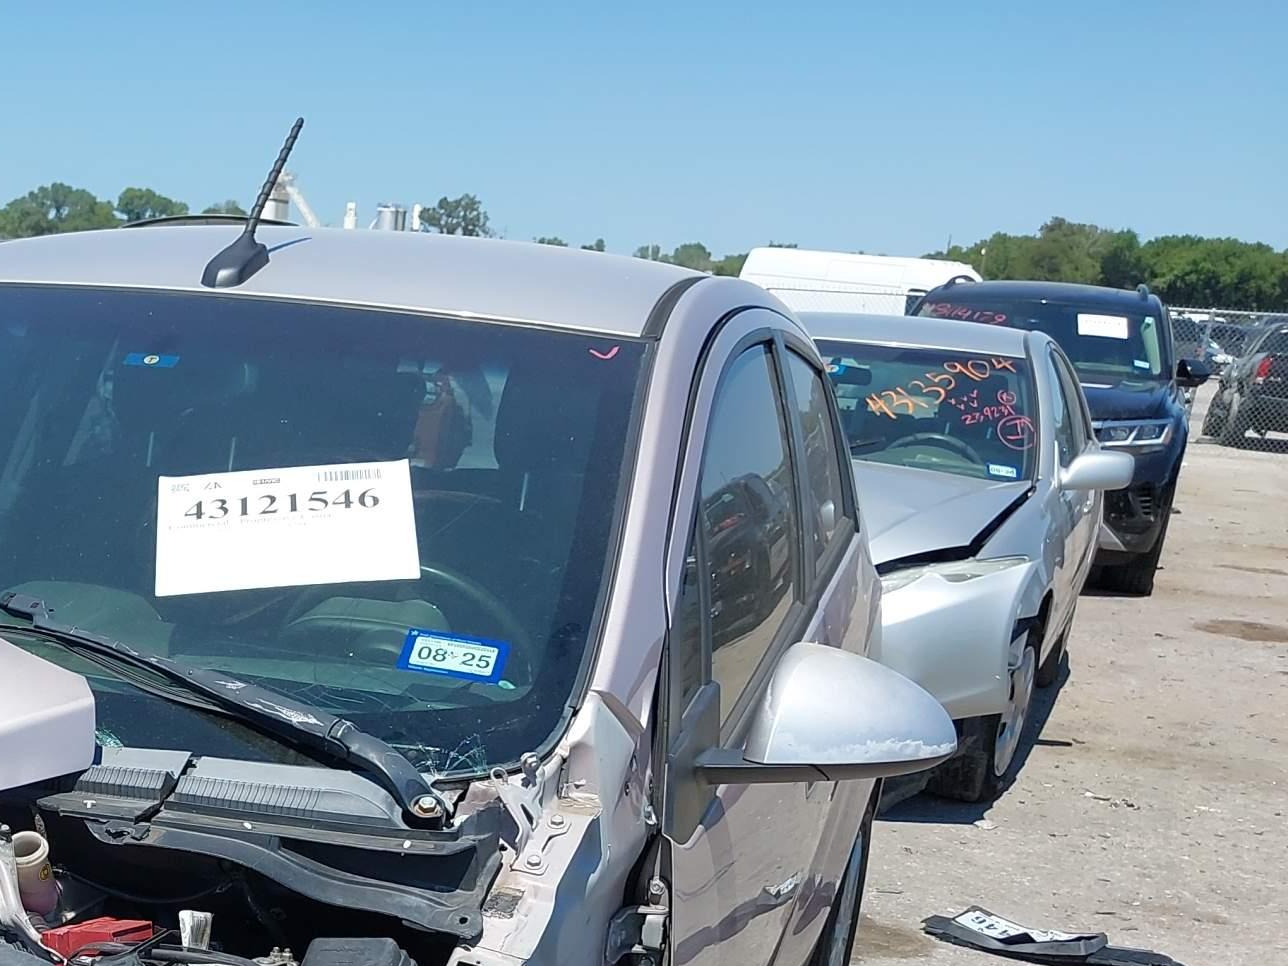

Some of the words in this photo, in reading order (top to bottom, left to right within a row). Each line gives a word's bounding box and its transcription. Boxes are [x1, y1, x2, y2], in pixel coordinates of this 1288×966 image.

[865, 357, 1017, 420] 43135904
[184, 487, 381, 520] 43121546
[417, 645, 448, 663] 08
[459, 652, 492, 669] 25
